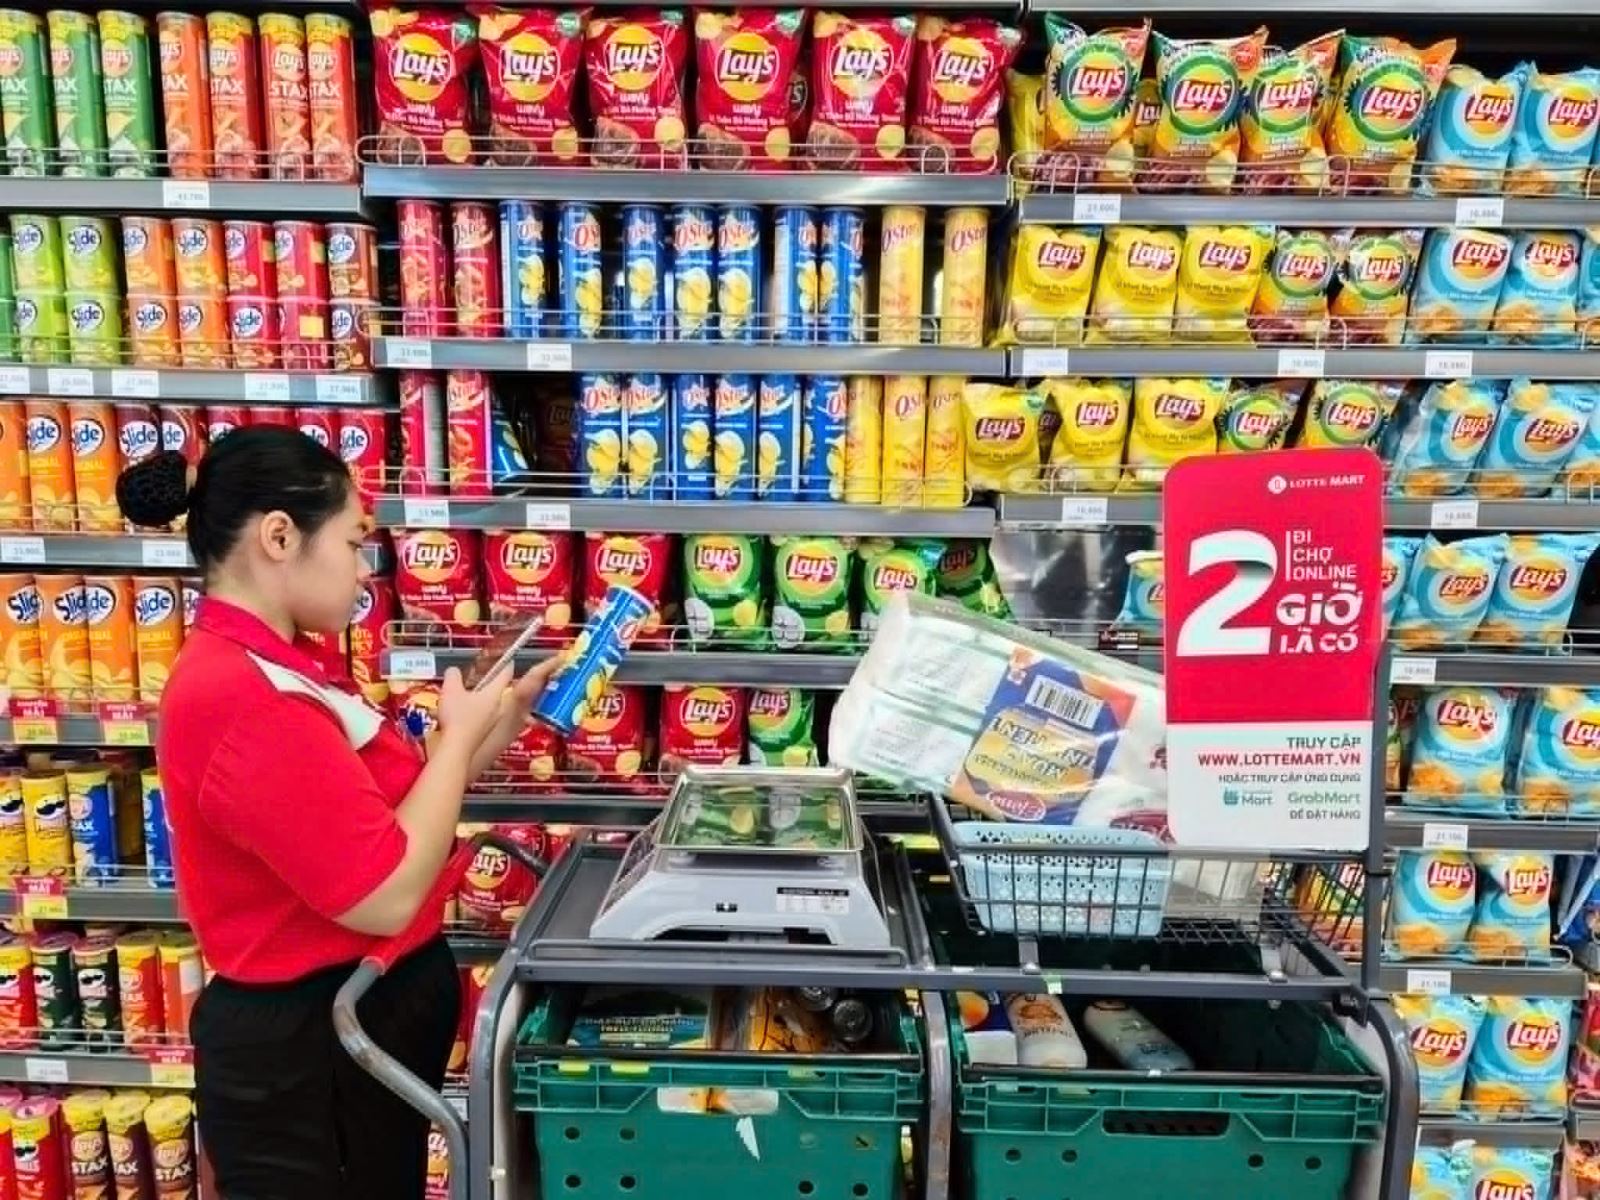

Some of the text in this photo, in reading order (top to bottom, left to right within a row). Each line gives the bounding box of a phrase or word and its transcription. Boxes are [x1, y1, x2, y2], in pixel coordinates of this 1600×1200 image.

[719, 49, 775, 82] Lay's
[1289, 474, 1366, 489] LOTTE MART
[1292, 529, 1312, 544] ĐI
[1292, 545, 1334, 565] CHỢ
[1293, 563, 1357, 581] ONLINE
[1176, 529, 1278, 656] 2
[1320, 625, 1359, 653] CÓ
[1286, 733, 1361, 751] TRUY CẬP
[1198, 753, 1361, 767] WWW.LOTTEMART.VN
[1287, 791, 1361, 804] GrabMart
[1330, 807, 1361, 820] HÀNG
[472, 852, 507, 876] ay's
